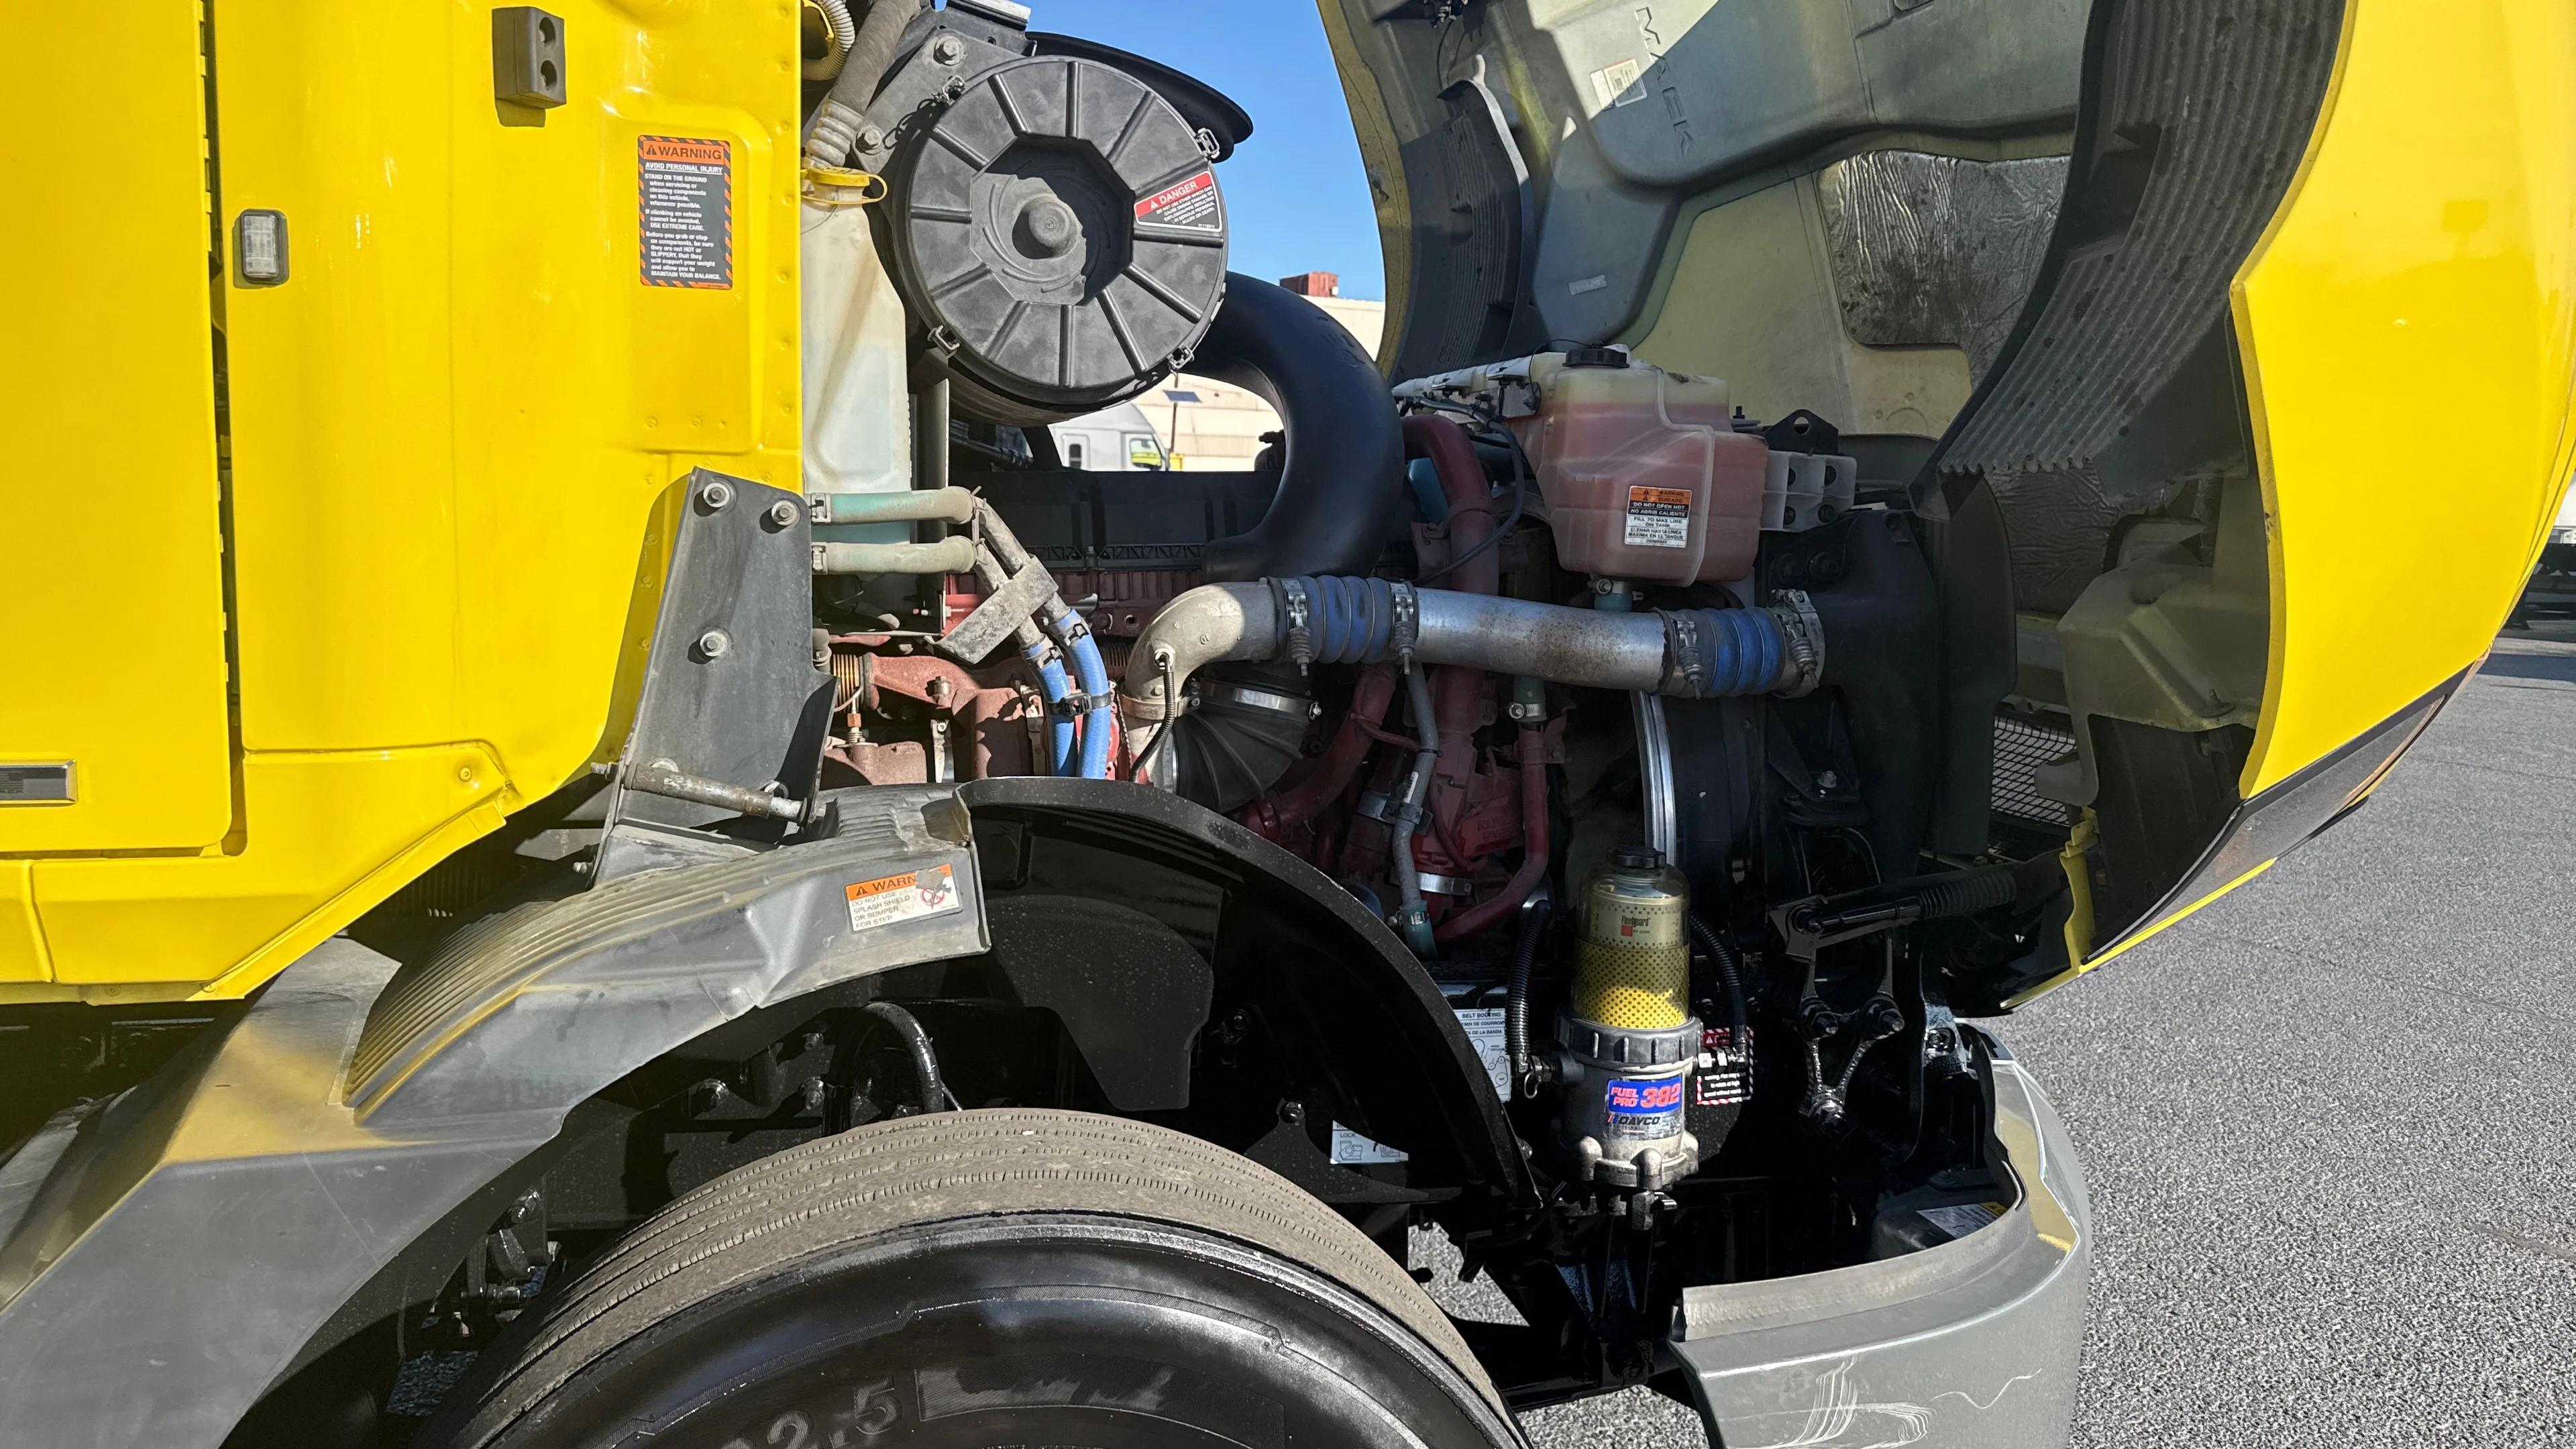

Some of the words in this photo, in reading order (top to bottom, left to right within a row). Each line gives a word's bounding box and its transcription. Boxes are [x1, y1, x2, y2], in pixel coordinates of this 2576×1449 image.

[1634, 7, 1696, 156] MACK
[658, 146, 721, 160] WARNING
[666, 164, 698, 172] PERSONAL
[1159, 181, 1197, 204] DANGER
[1179, 196, 1191, 204] ETHER
[1164, 208, 1177, 216] CAUSE
[1195, 202, 1215, 213] PERSONAL
[1182, 216, 1195, 224] INJURY
[1201, 207, 1215, 215] DEATH.
[872, 875, 916, 892] WARN
[853, 902, 881, 914] SPLASH
[884, 895, 910, 906] SHIELD
[867, 906, 899, 918] BUMPER
[873, 916, 892, 924] STEP
[1621, 915, 1649, 927] Fleetguard
[1610, 1086, 1639, 1098] FUEL
[1640, 1083, 1681, 1108] 382
[1613, 1096, 1640, 1108] PRO
[1619, 1116, 1660, 1126] DAYCO
